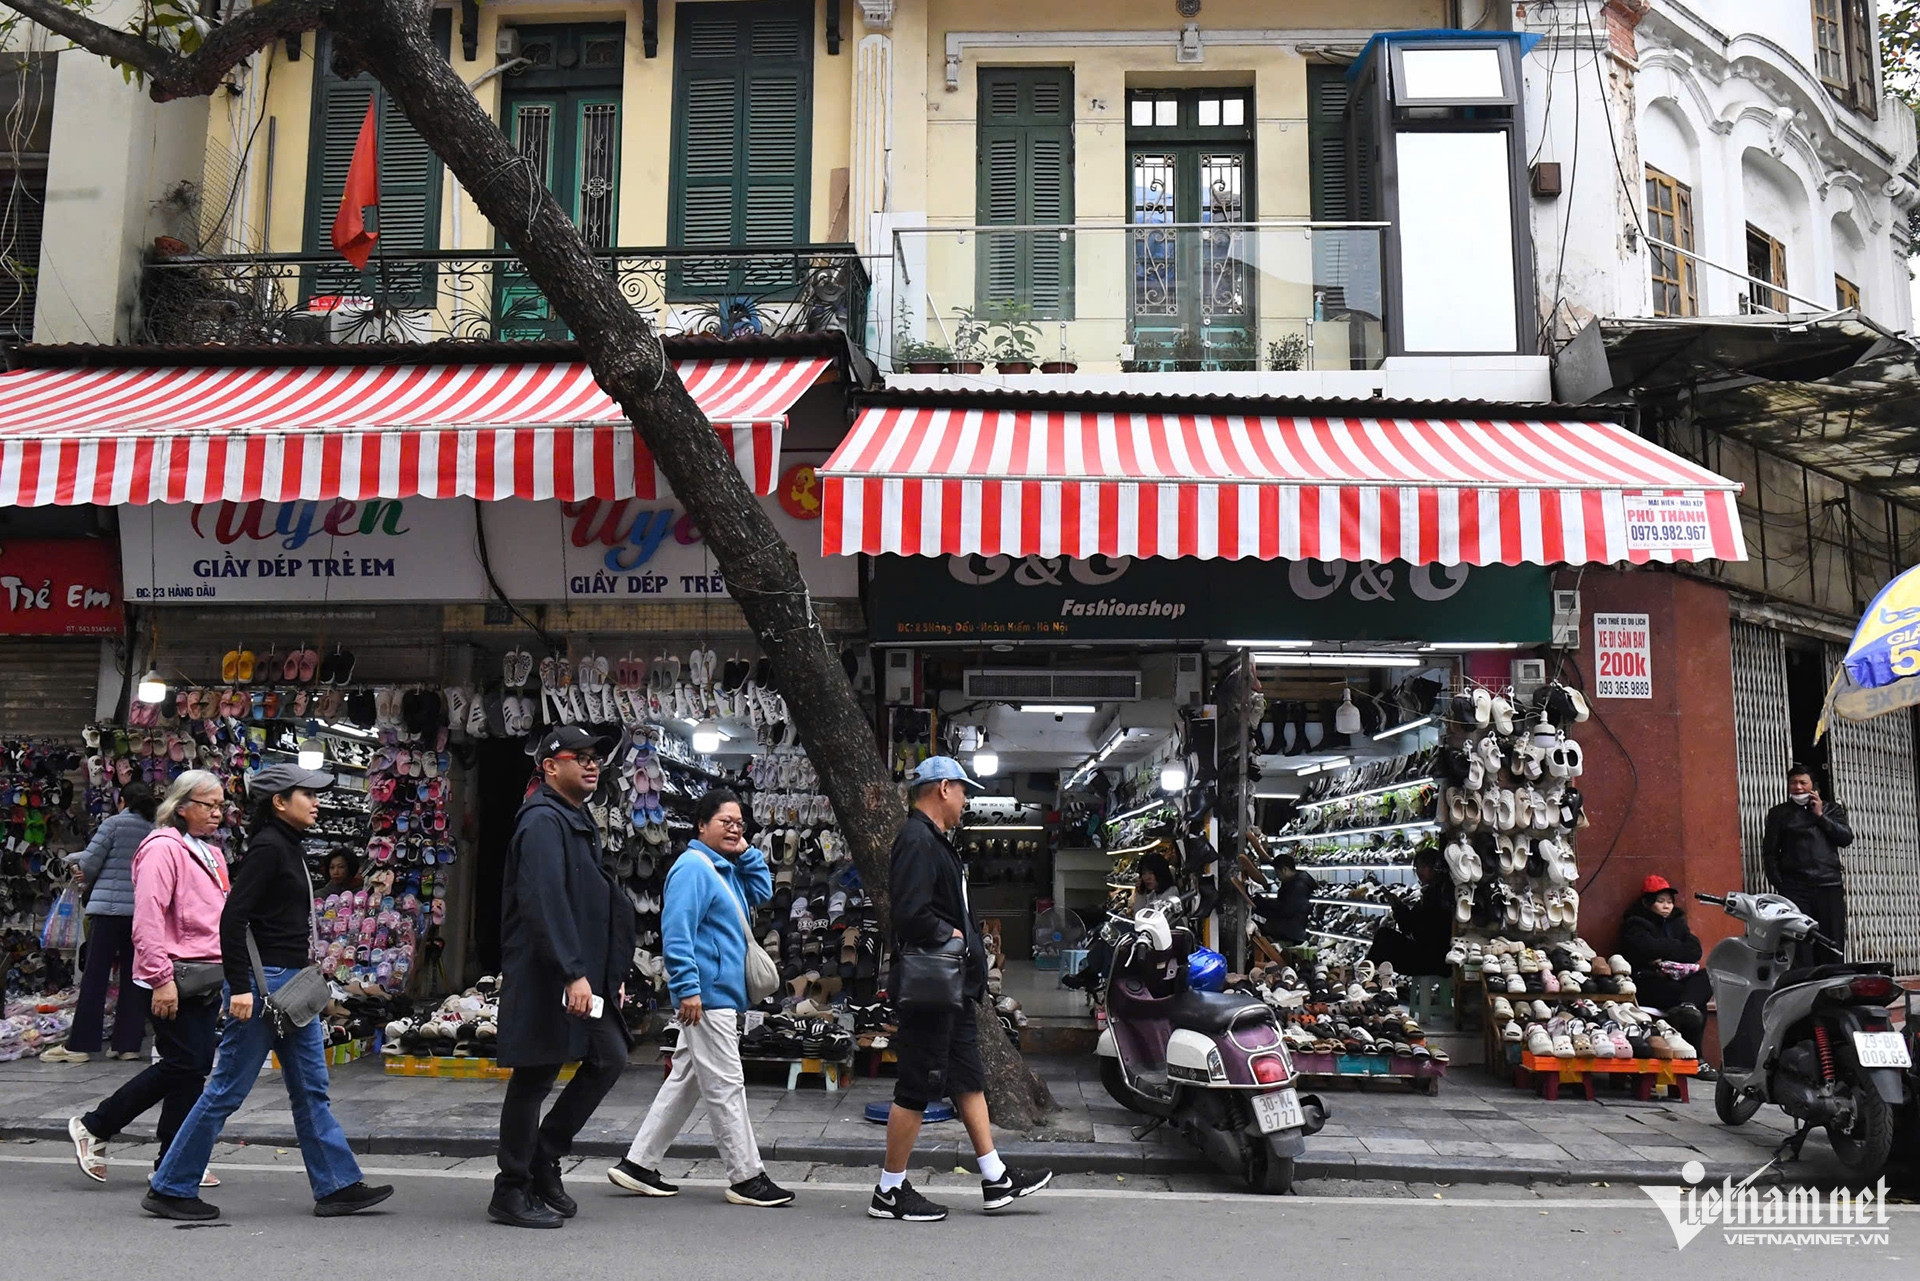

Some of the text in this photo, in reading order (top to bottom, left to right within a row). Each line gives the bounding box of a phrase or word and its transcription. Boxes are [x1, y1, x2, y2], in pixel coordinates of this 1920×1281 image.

[1631, 525, 1706, 541] 0979.982.967
[258, 554, 302, 577] DÉP
[308, 551, 355, 577] TRẺ
[361, 558, 395, 577] EM
[153, 586, 165, 597] 23
[168, 582, 193, 597] HÀNG
[627, 570, 668, 593] DÉP
[680, 569, 723, 593] TRẺ
[67, 585, 111, 609] Em
[1061, 598, 1185, 620] Fashionshop
[1597, 617, 1607, 625] CHO
[1599, 631, 1607, 648] XE
[1633, 631, 1645, 648] BAY
[1600, 652, 1646, 677] 200k
[1599, 681, 1612, 695] 093
[1615, 681, 1629, 695] 365
[1862, 1050, 1907, 1065] 008.65
[1265, 1108, 1296, 1129] 9727
